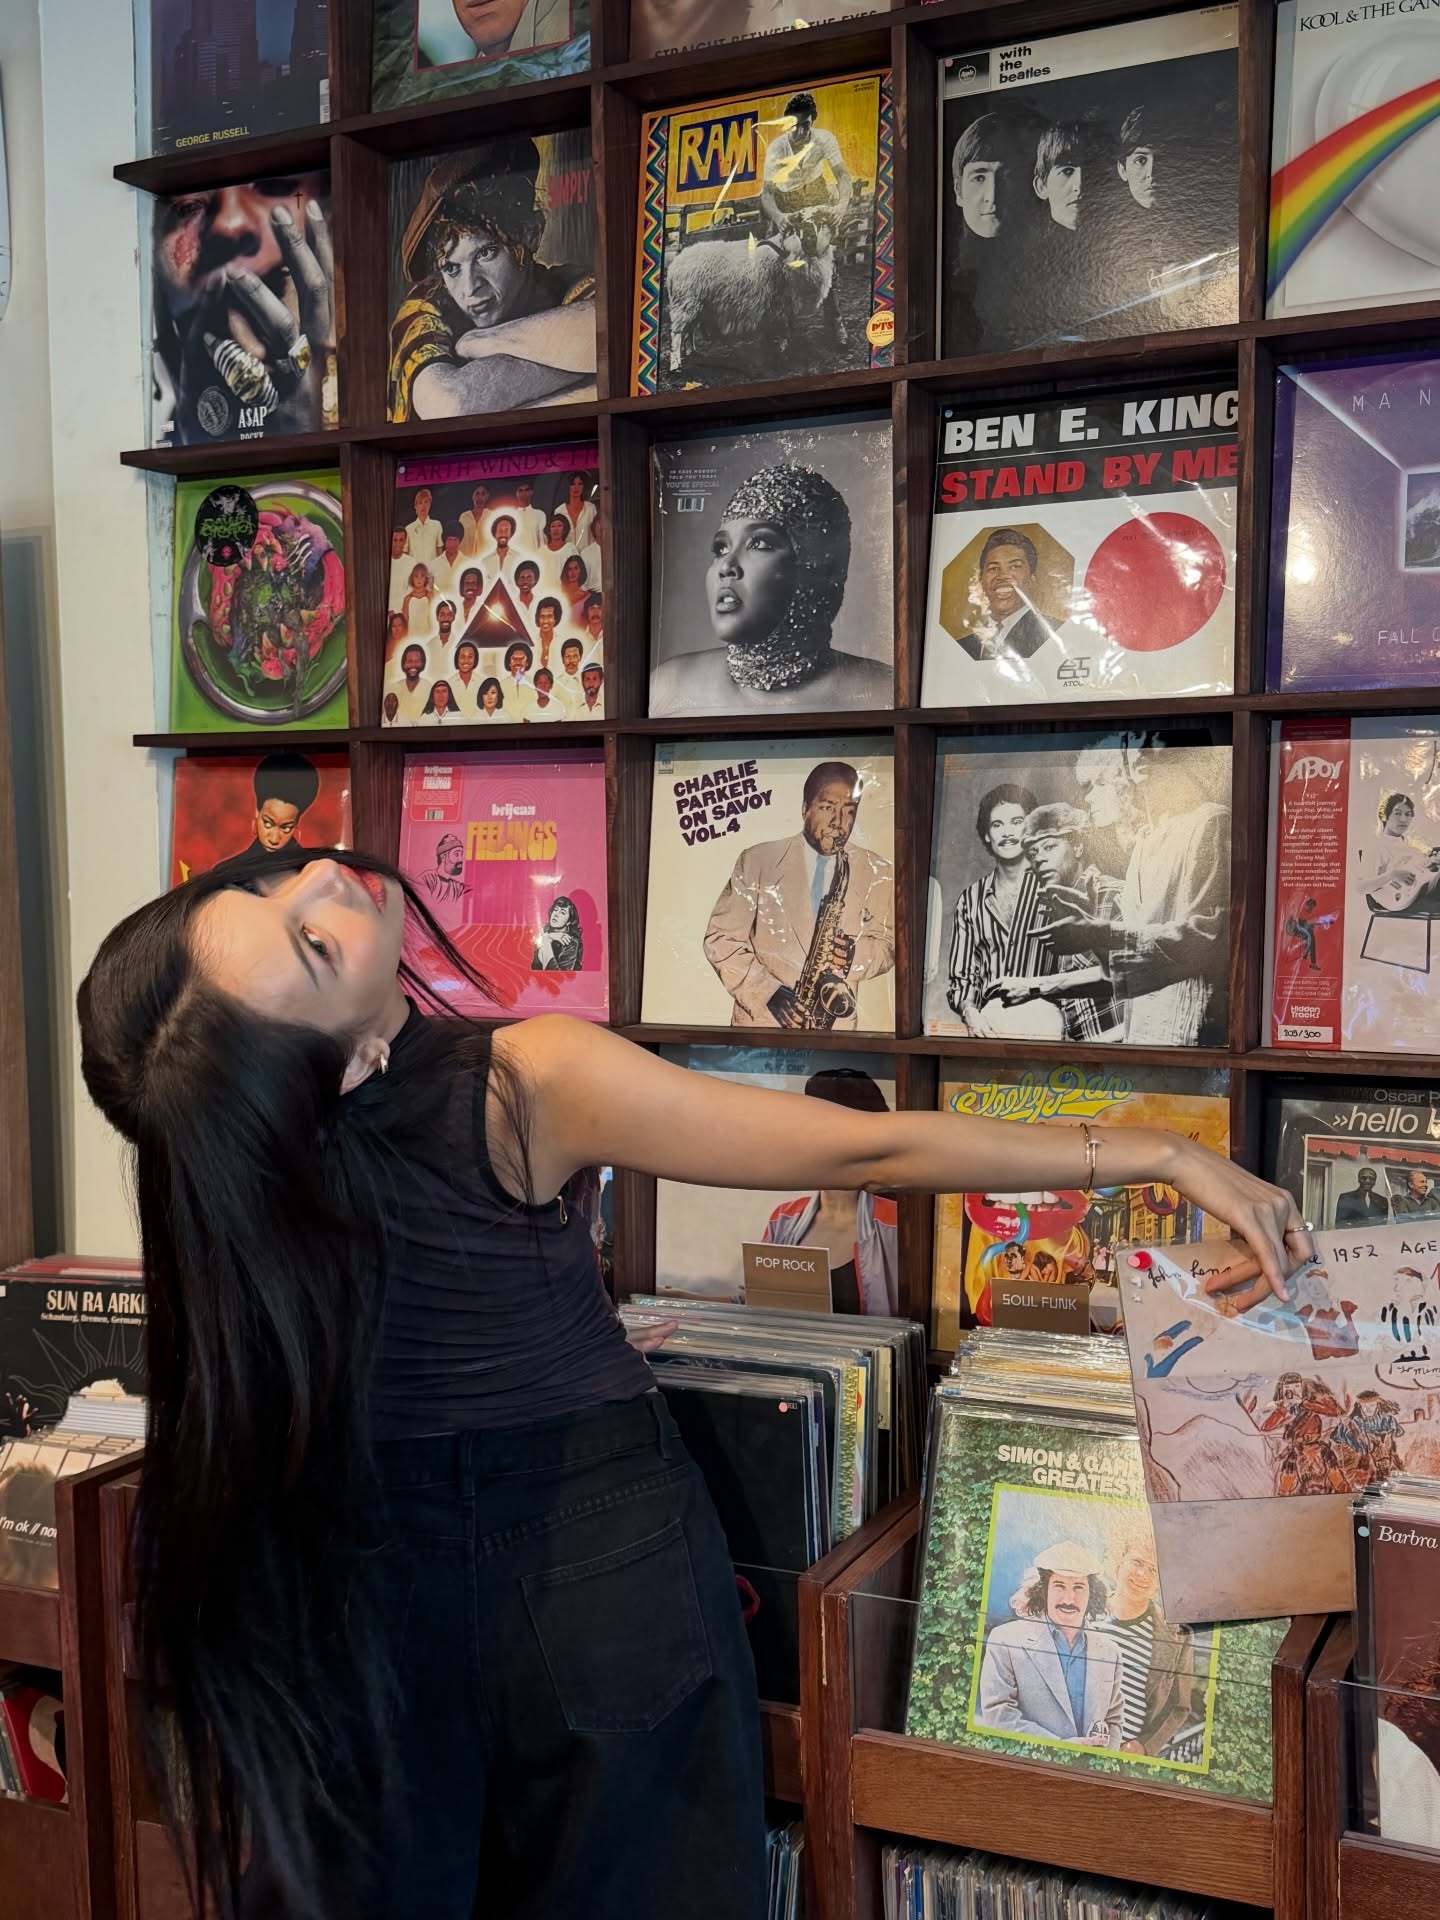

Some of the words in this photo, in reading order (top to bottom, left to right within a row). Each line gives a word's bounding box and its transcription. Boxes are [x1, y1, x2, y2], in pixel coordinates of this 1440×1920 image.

[1300, 11, 1344, 32] KOOL
[1345, 9, 1360, 23] &
[1360, 1, 1395, 20] THE
[1000, 46, 1032, 60] with
[1000, 60, 1022, 72] the
[1000, 66, 1051, 84] beatles
[175, 133, 210, 148] GEORGE
[212, 126, 250, 141] RUSSELL
[680, 118, 755, 185] RAM
[238, 406, 267, 429] A$AP
[944, 412, 1036, 455] BEN
[1058, 407, 1100, 443] E.
[1121, 390, 1239, 436] KING
[404, 461, 471, 482] EARTH
[480, 454, 539, 474] WIND
[545, 453, 561, 468] &
[941, 461, 1086, 505] STAND
[1102, 453, 1162, 489] BY
[1172, 444, 1239, 482] ME
[1377, 628, 1420, 646] FALL
[673, 759, 759, 798] CHARLIE
[1284, 756, 1344, 784] ABOY
[676, 778, 758, 815] PARKER
[491, 803, 536, 821] brijean
[679, 809, 708, 830] ON
[711, 789, 773, 821] SAVOY
[465, 820, 558, 862] FEELINGS
[1290, 1005, 1321, 1014] Hidden
[1291, 1011, 1320, 1019] Tracks
[1046, 1065, 1134, 1118] Dan
[1374, 1089, 1426, 1103] Oscar
[1333, 1245, 1379, 1262] 1952
[1400, 1240, 1438, 1255] AGE
[755, 1256, 780, 1269] POP
[782, 1259, 816, 1273] ROCK
[46, 1289, 78, 1311] SUN
[82, 1291, 104, 1313] RA
[1002, 1293, 1039, 1308] SOUL
[1041, 1296, 1077, 1311] FUNK
[110, 1315, 142, 1327] Germany
[998, 1444, 1063, 1468] SIMON
[1065, 1452, 1081, 1471] &
[1033, 1467, 1138, 1497] GREATEST
[15, 1520, 30, 1533] ok
[1376, 1525, 1439, 1549] Barbra
